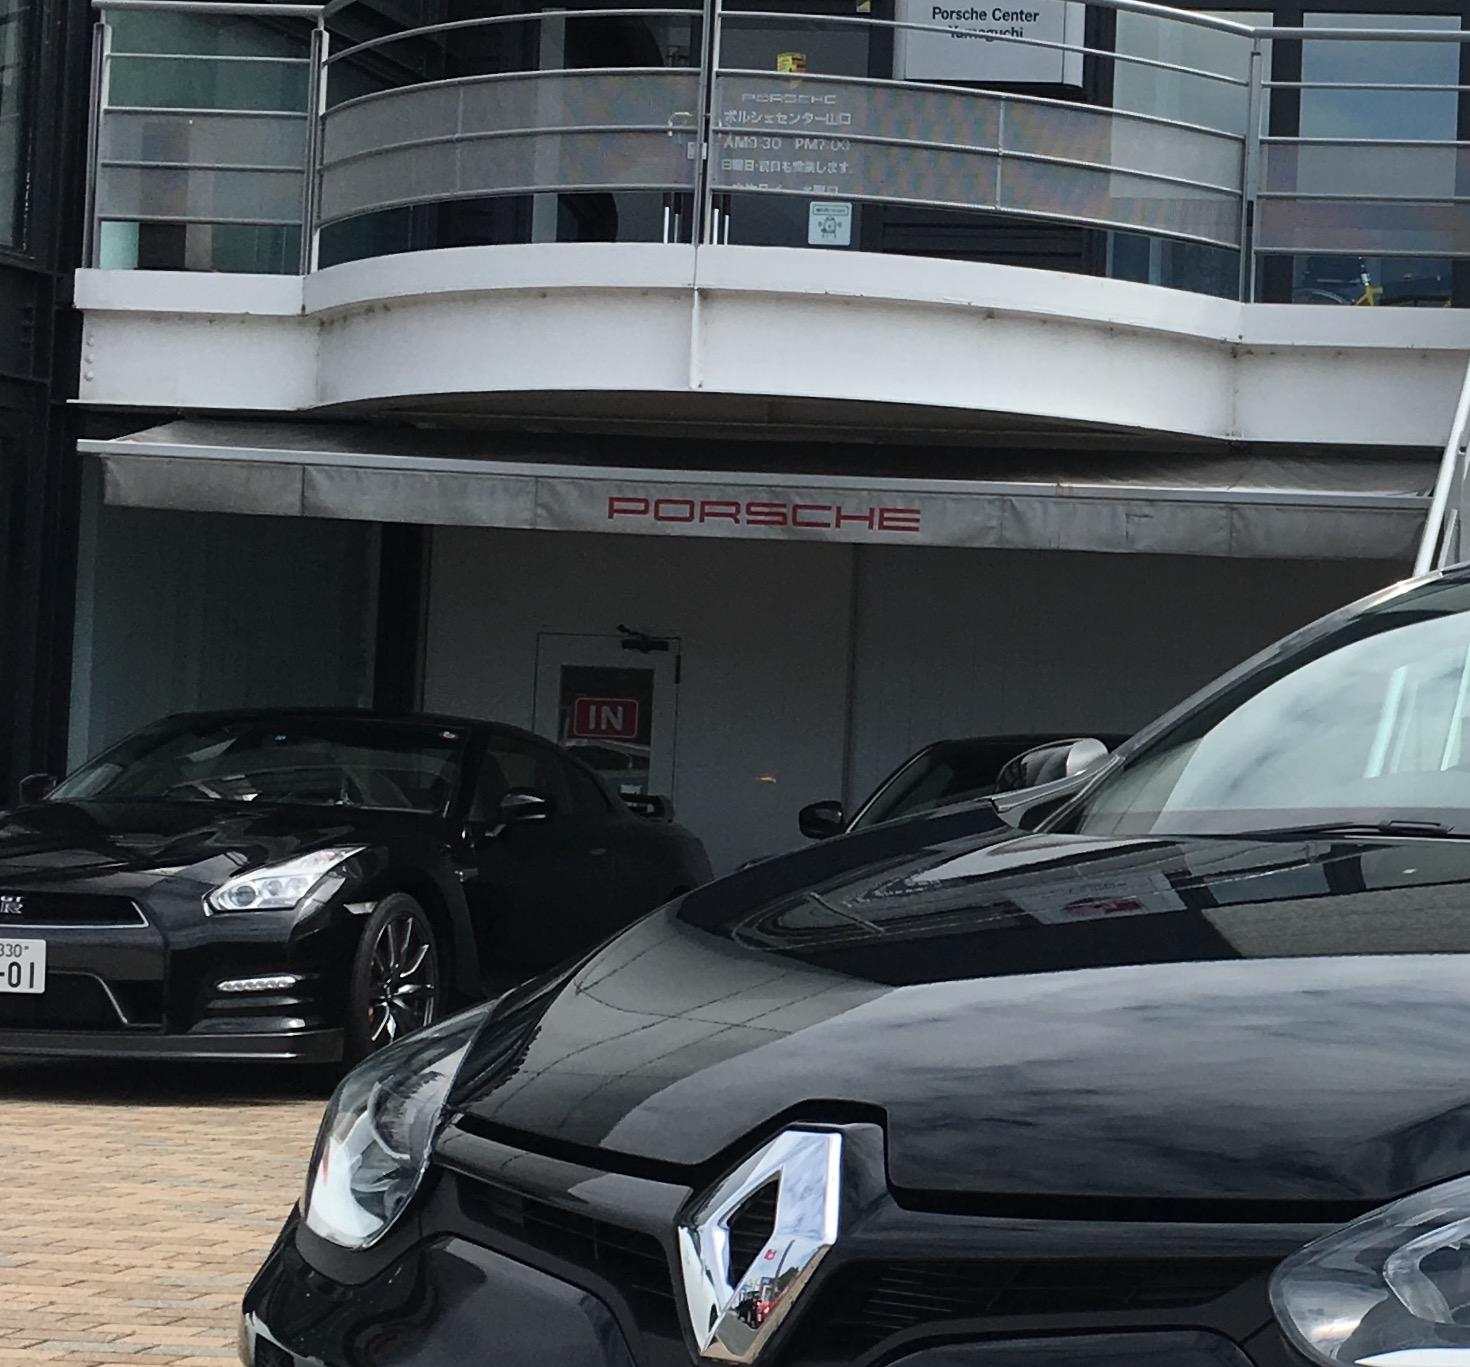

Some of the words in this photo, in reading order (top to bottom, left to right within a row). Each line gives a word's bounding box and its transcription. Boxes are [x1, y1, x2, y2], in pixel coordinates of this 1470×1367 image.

[932, 6, 987, 21] Porsche
[991, 7, 1040, 22] Center
[607, 496, 921, 532] PORSCHE
[588, 704, 624, 731] IN
